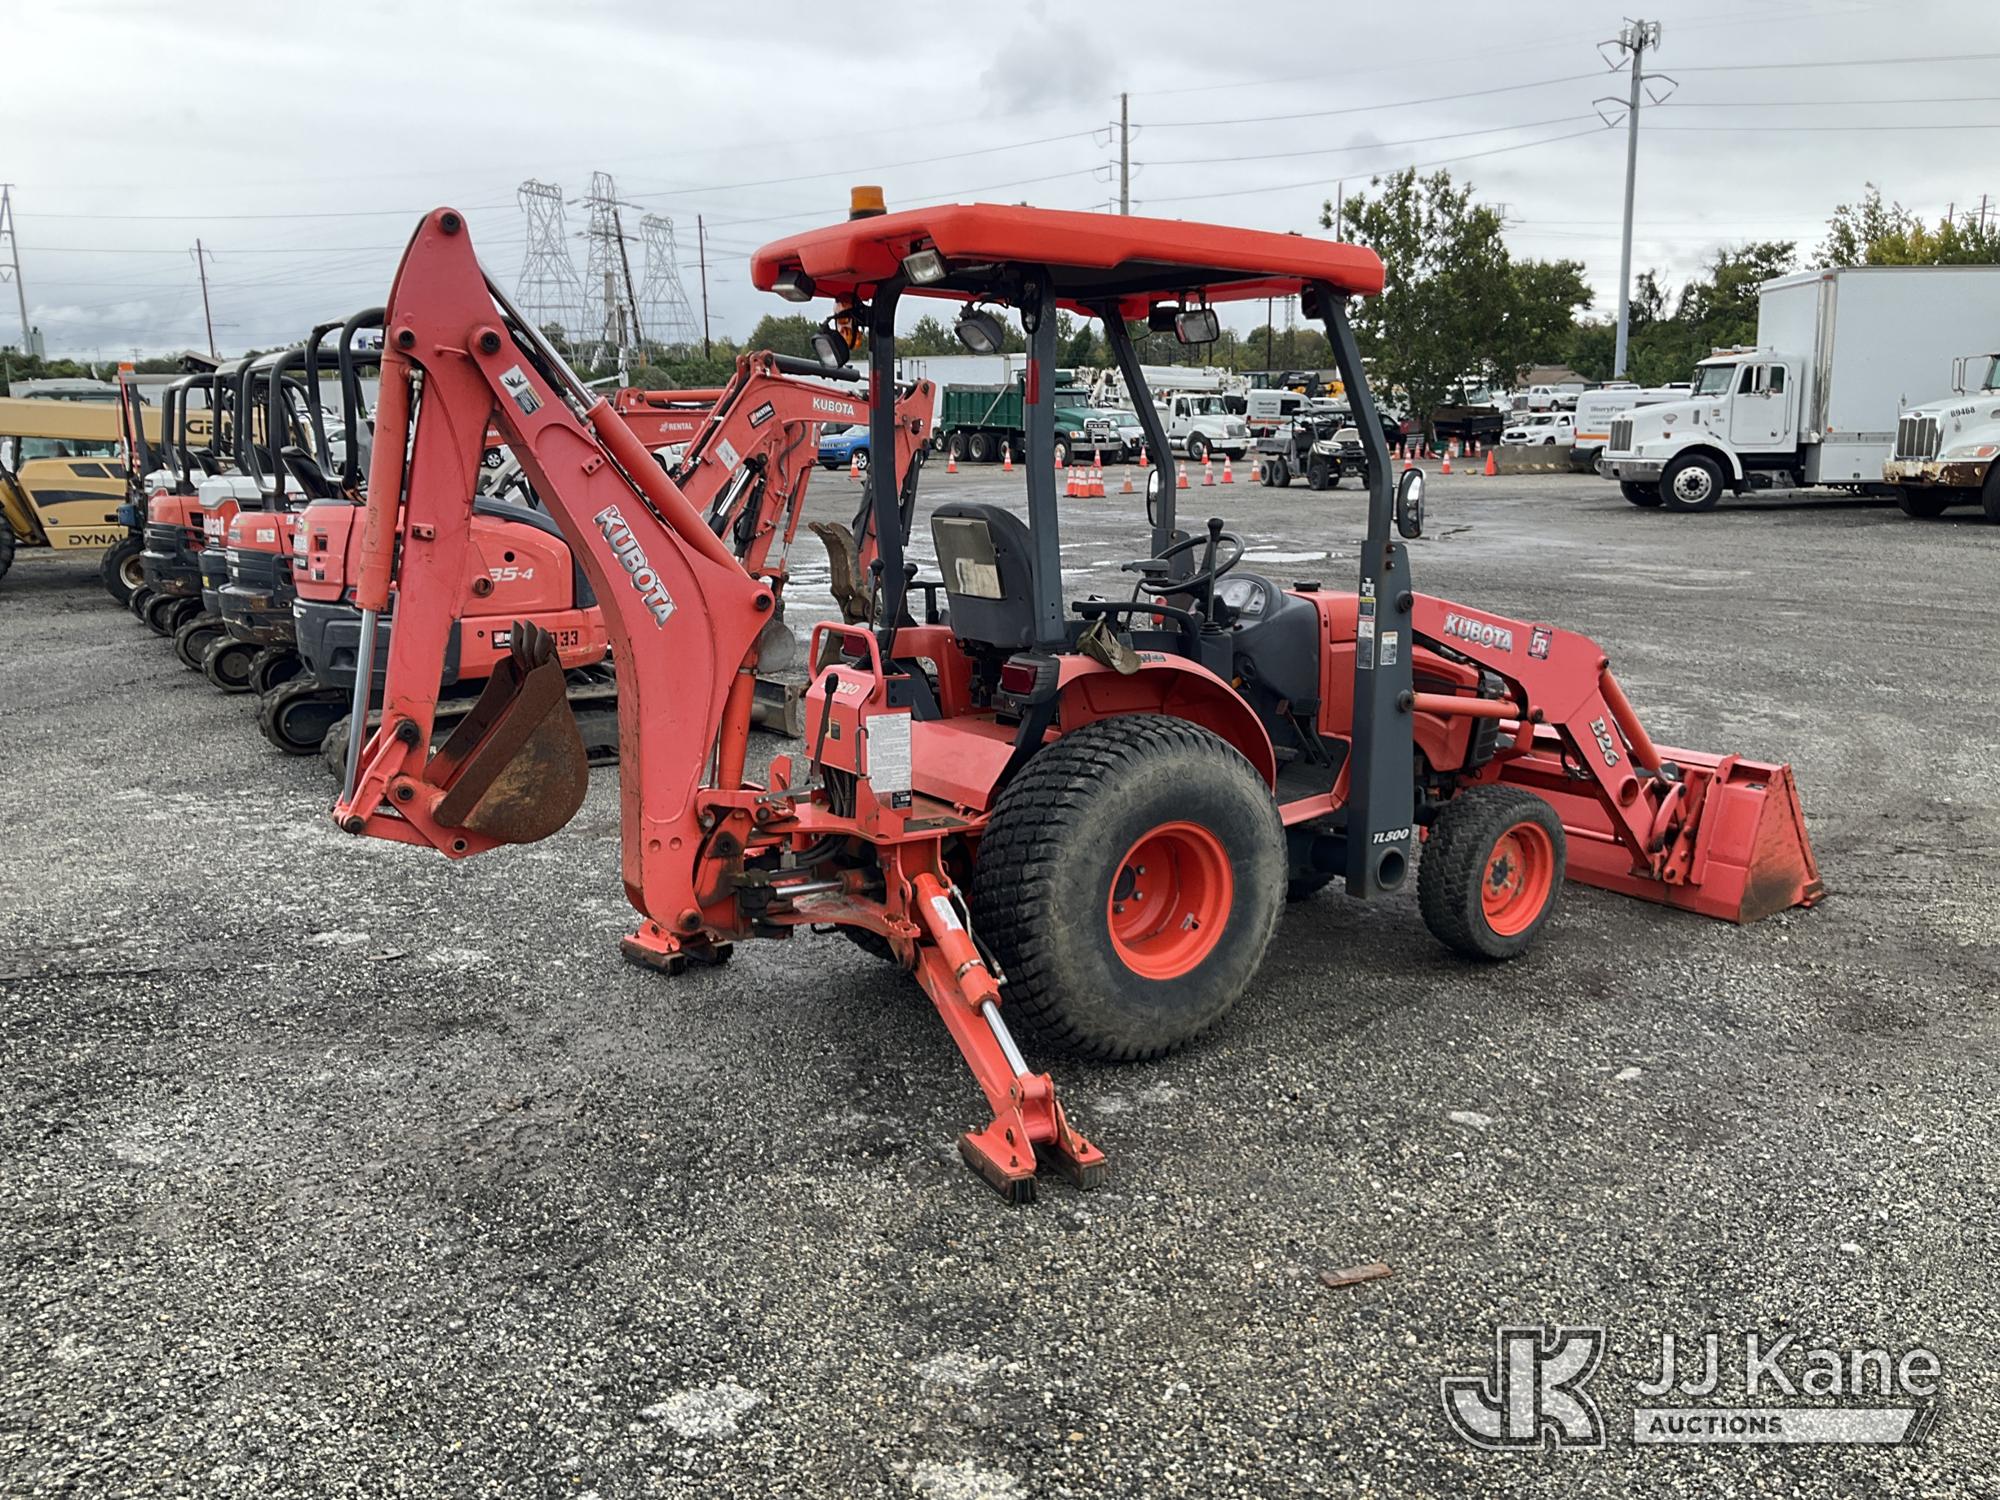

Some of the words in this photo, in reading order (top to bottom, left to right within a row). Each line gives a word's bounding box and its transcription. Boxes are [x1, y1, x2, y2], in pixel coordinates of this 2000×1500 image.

[813, 397, 854, 415] KUBOTA
[669, 422, 693, 431] RENTAL
[69, 534, 124, 545] DYNA
[593, 504, 678, 630] KUBOTA
[1444, 613, 1512, 653] KUBOTA
[1589, 716, 1620, 766] B26
[1373, 828, 1410, 844] TL500
